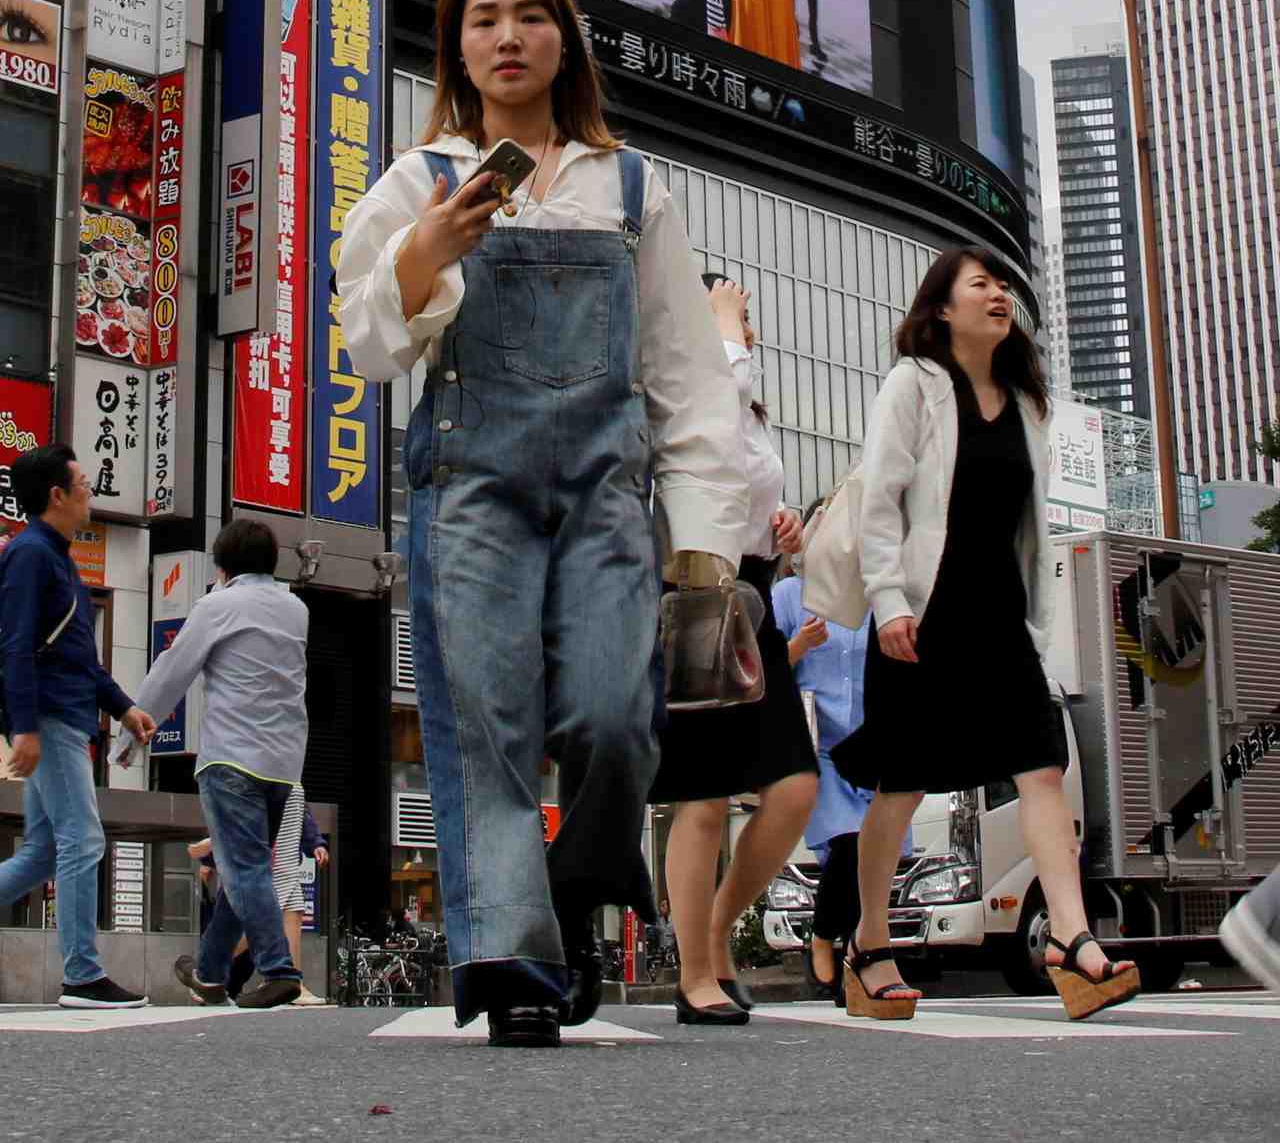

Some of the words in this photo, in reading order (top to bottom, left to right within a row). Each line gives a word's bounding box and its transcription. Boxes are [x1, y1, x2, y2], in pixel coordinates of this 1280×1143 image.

[93, 17, 152, 46] Rydia
[158, 85, 183, 207] 飲み放題
[225, 207, 234, 263] SHINJUKU
[234, 202, 254, 289] LABI
[95, 379, 121, 497] 日高屋
[156, 729, 183, 743] プロミス
